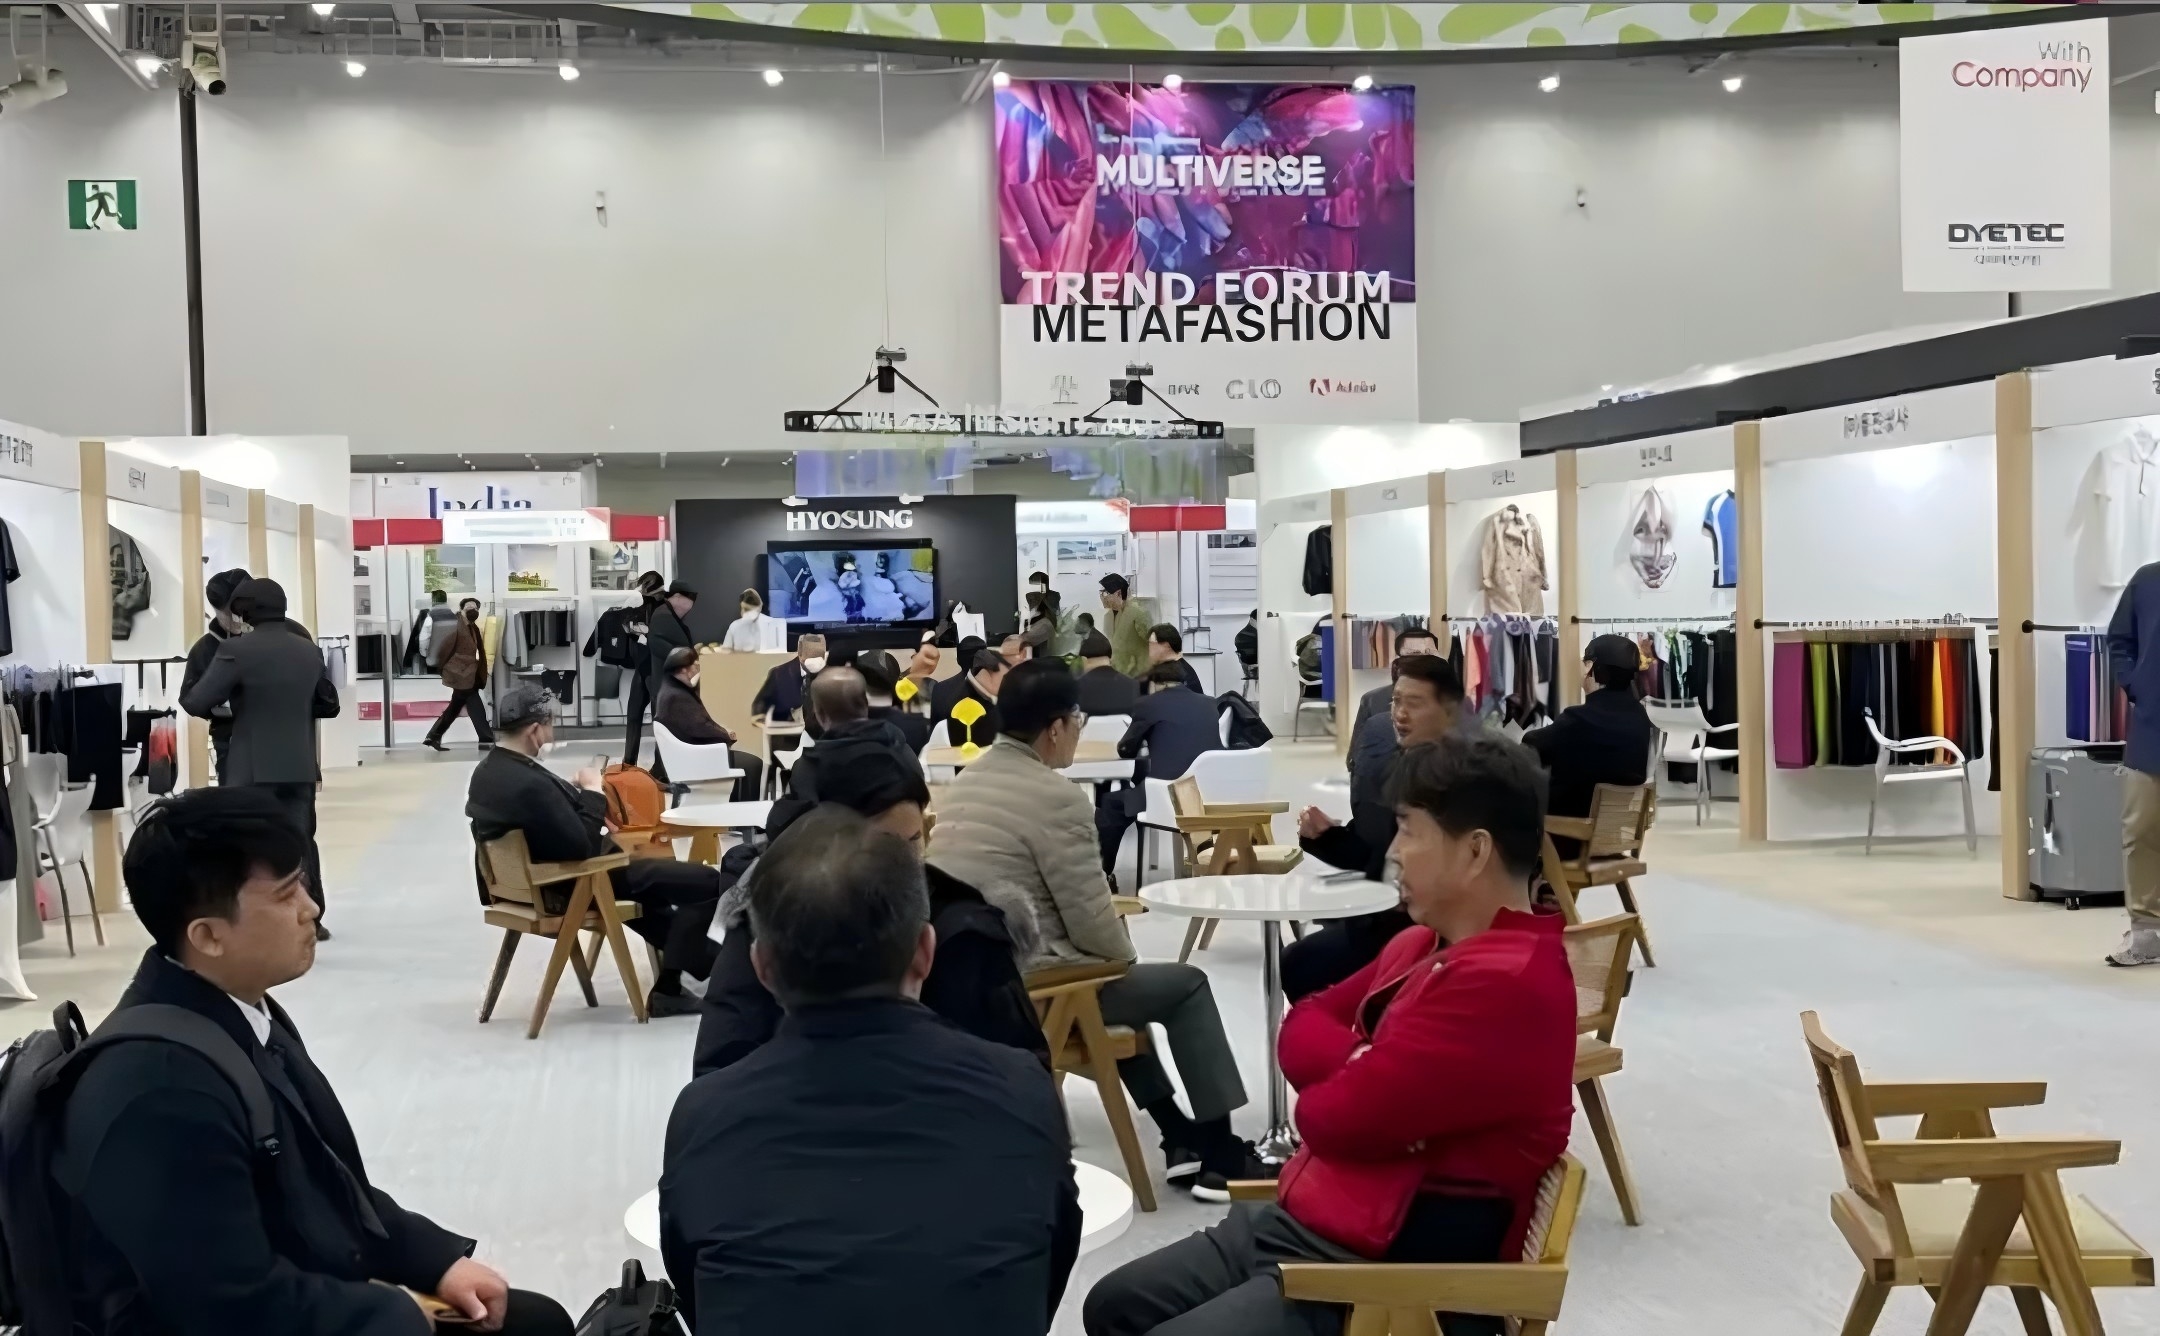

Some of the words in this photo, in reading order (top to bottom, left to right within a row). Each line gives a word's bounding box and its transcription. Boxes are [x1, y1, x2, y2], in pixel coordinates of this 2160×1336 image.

[2038, 41, 2091, 63] With
[1952, 61, 2092, 92] Company
[1096, 153, 1325, 190] MULTIVERSE
[1948, 223, 2065, 243] DYETEC
[1021, 270, 1196, 305] TREND
[1215, 270, 1391, 304] FORUM
[1033, 303, 1391, 343] METAFASHION
[785, 509, 914, 531] HYOSUNG
